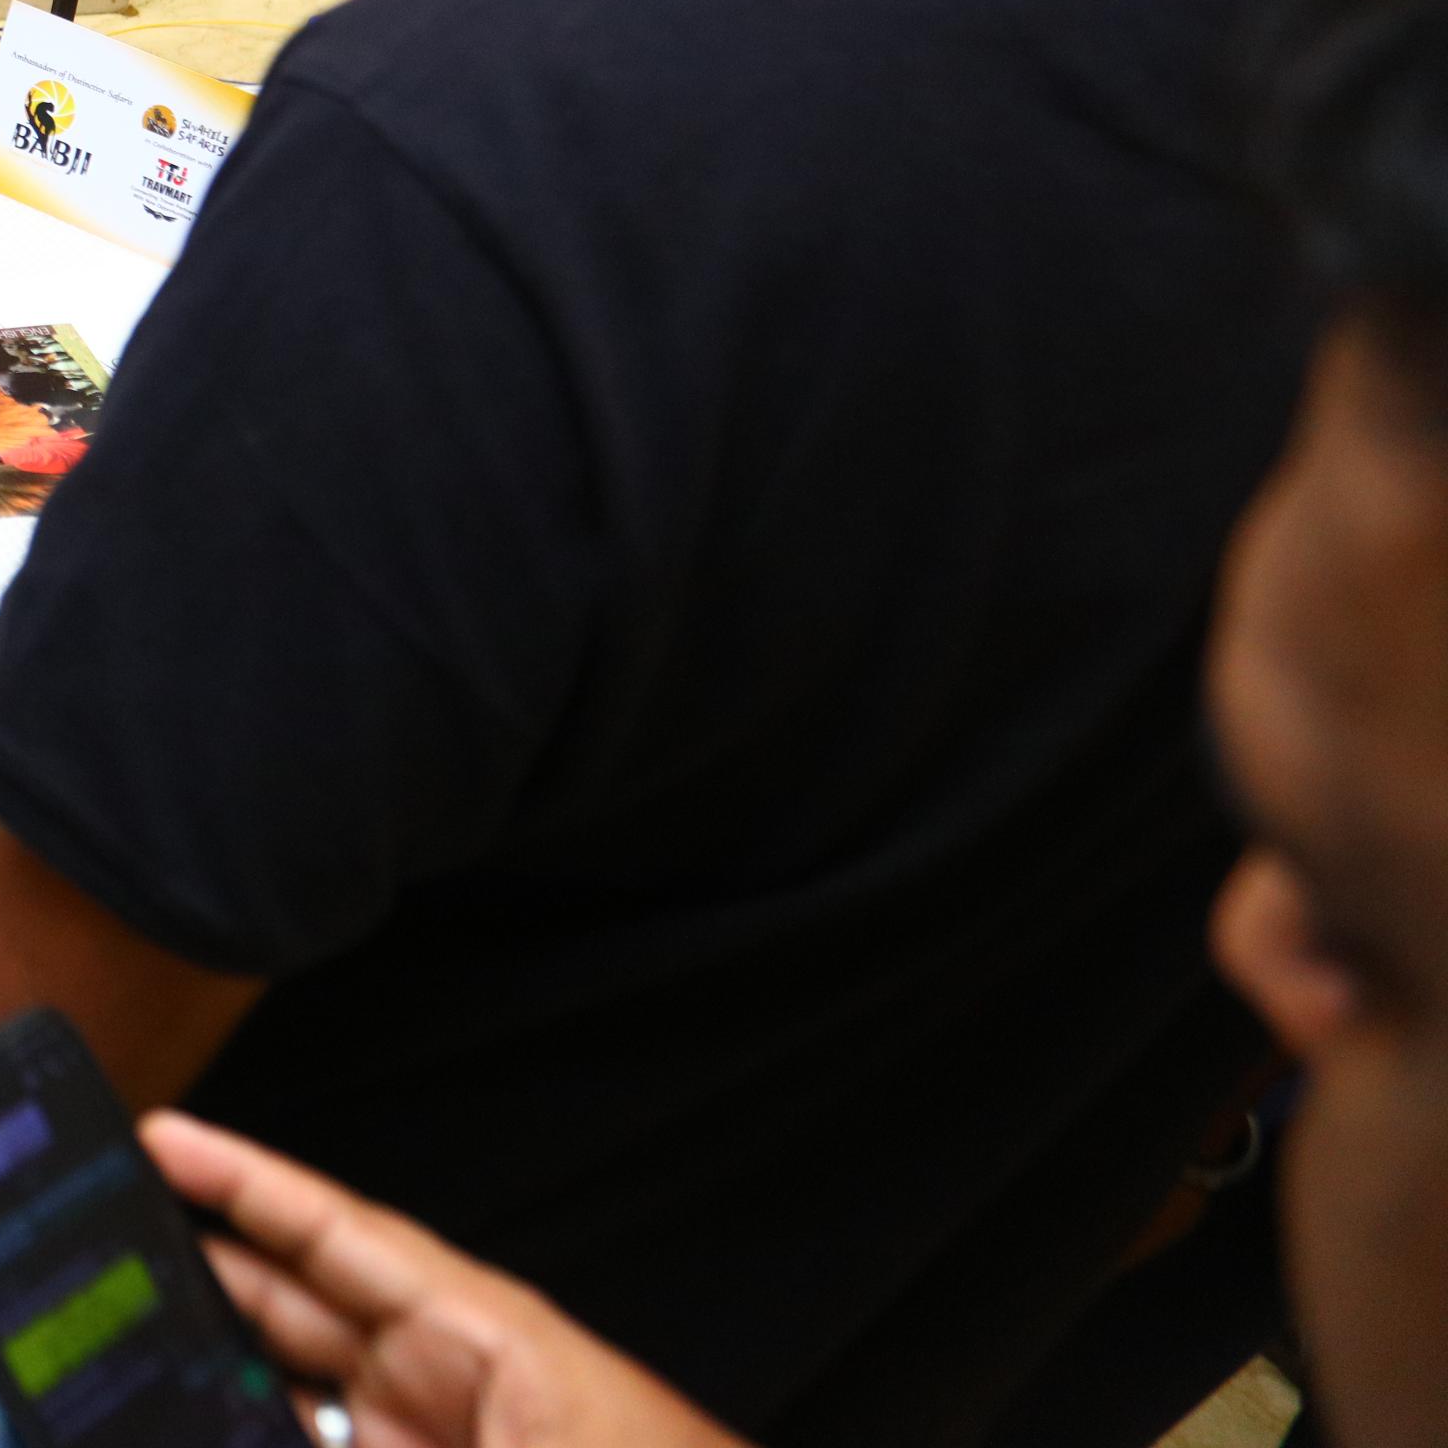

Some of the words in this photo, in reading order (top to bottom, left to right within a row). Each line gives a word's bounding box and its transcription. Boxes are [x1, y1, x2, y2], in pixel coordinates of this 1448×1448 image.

[12, 121, 93, 176] BABJI
[178, 130, 225, 156] SAFARIS
[142, 176, 193, 205] TRAVMART
